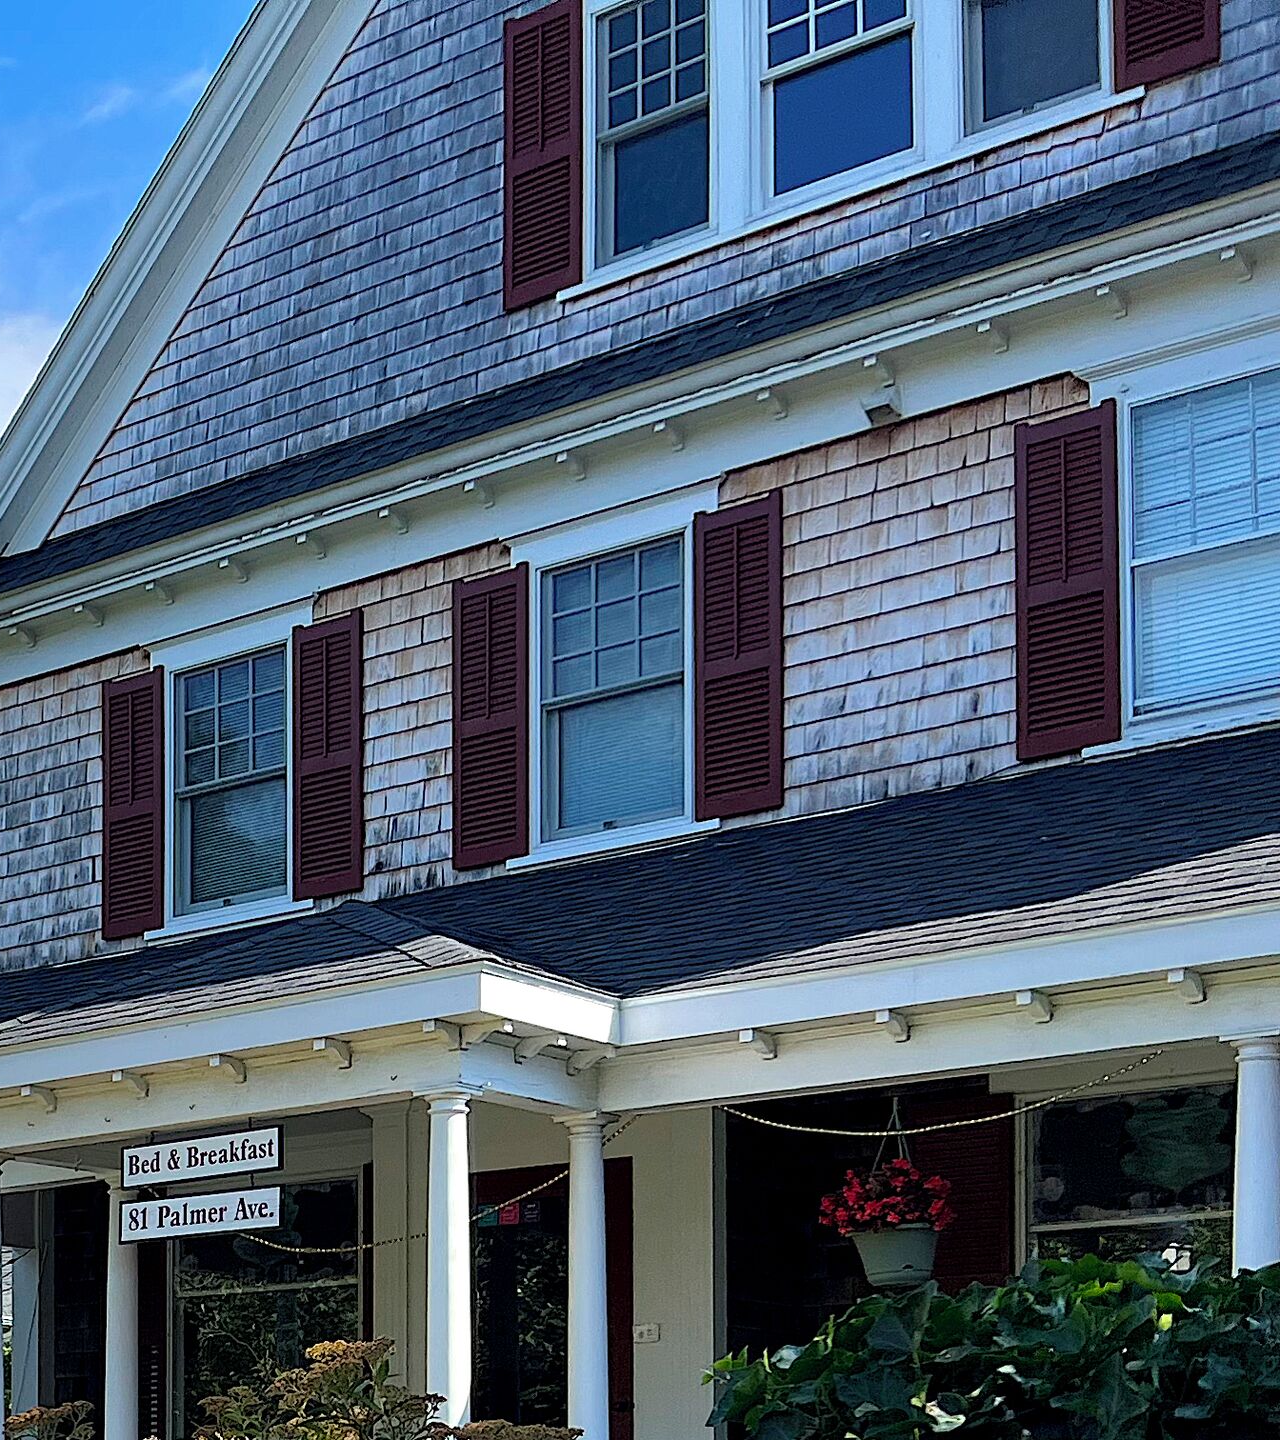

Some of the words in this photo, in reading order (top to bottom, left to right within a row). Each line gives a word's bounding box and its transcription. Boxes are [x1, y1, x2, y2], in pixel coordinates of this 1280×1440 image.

[128, 1151, 160, 1175] Bed
[167, 1149, 181, 1170] &
[186, 1138, 274, 1168] Breakfast
[128, 1207, 148, 1231] 81
[157, 1203, 227, 1228] Palmer
[235, 1198, 274, 1221] Ave.
